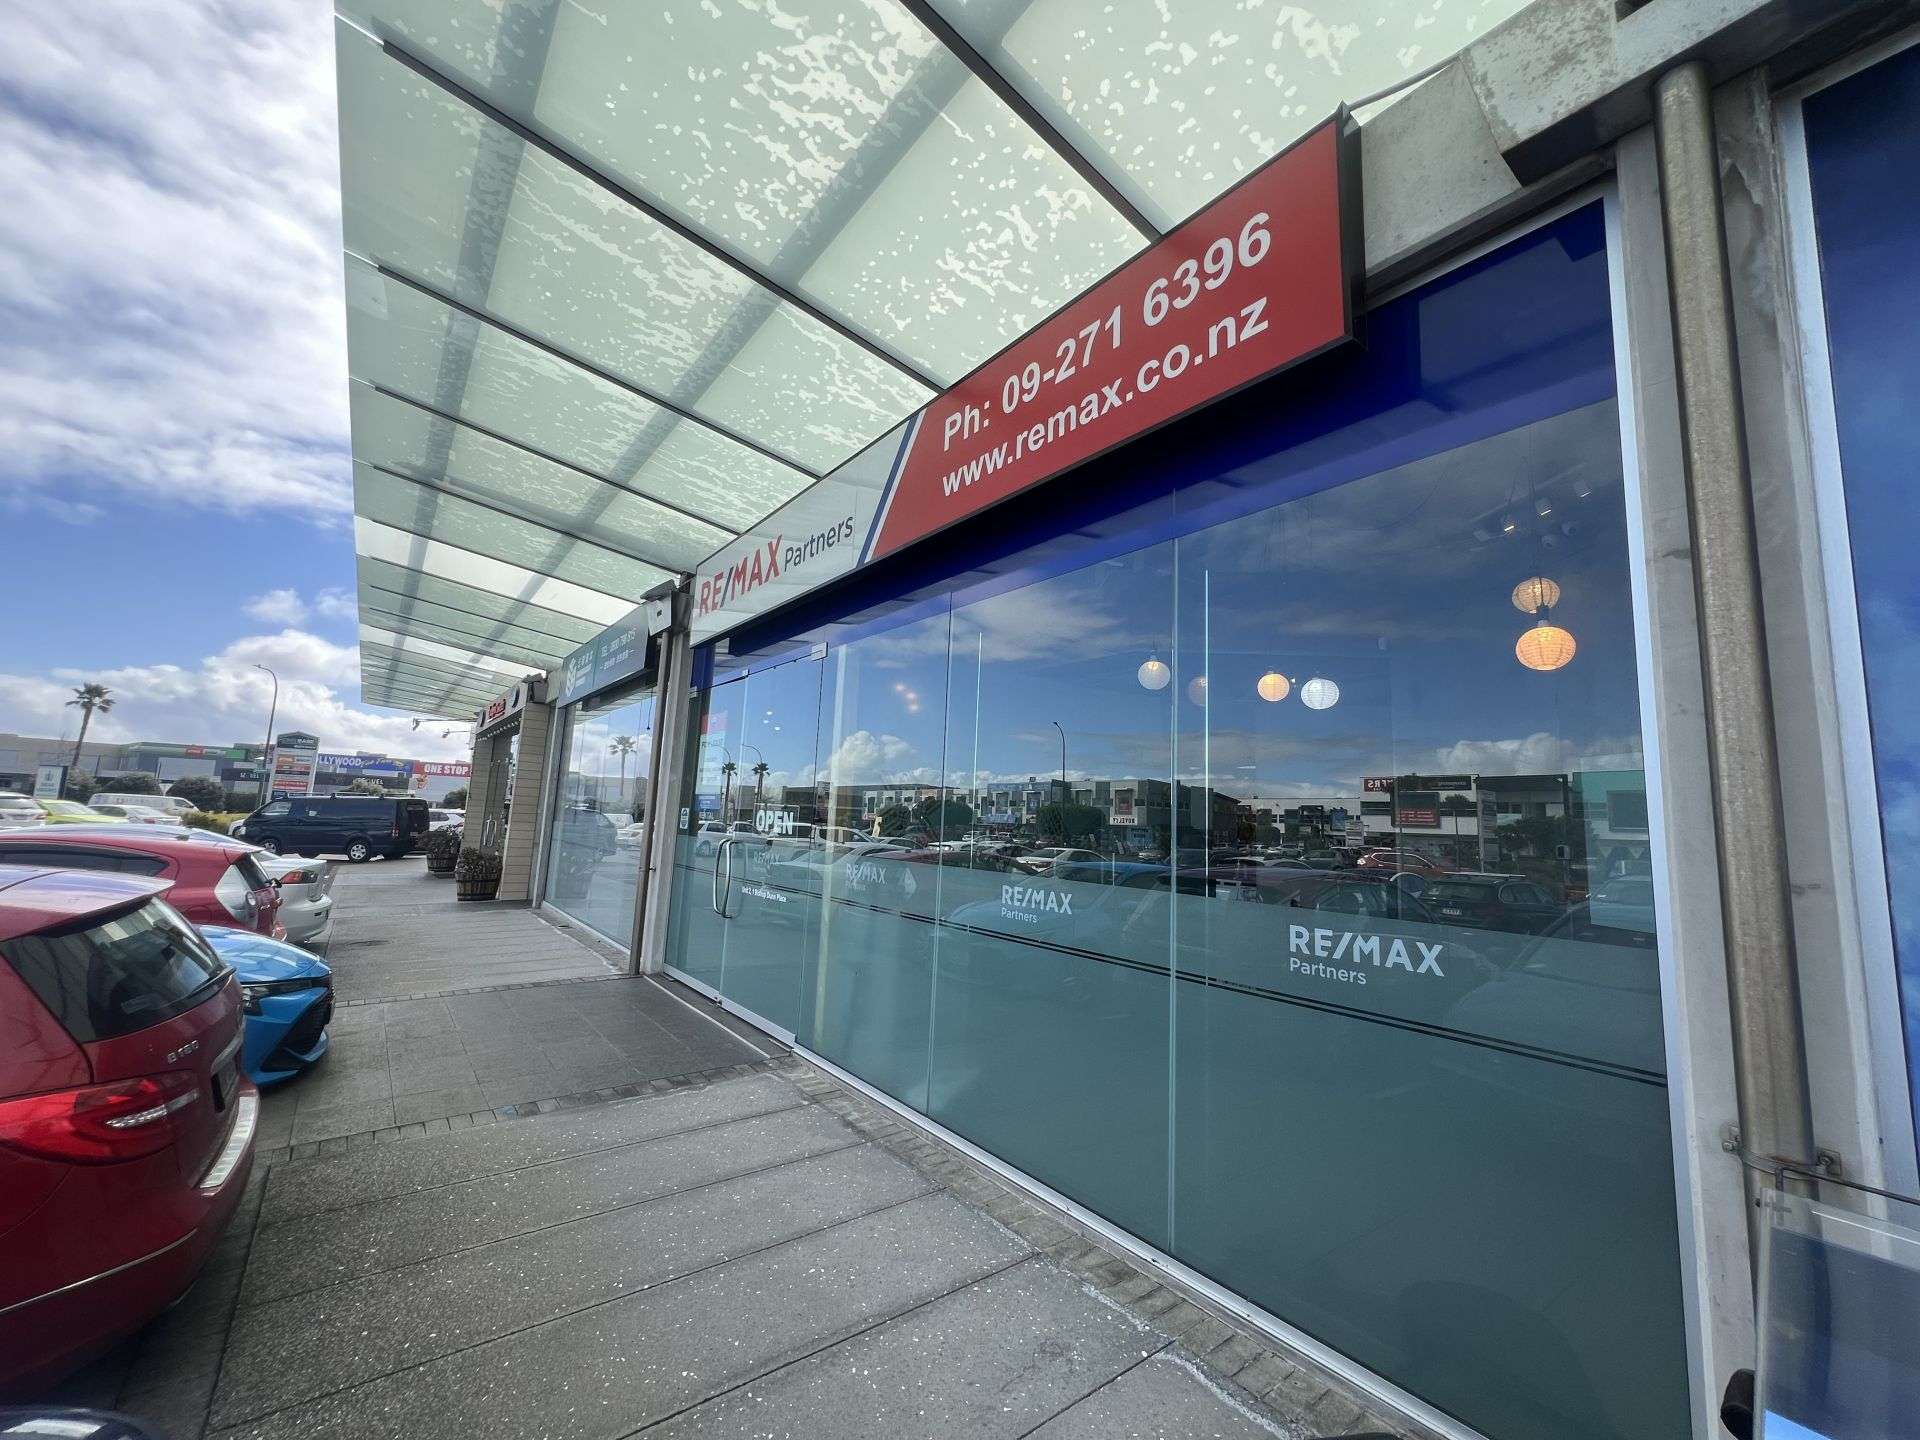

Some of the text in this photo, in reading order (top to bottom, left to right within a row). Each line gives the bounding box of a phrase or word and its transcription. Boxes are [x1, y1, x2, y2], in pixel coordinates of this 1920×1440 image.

[943, 212, 1271, 452] Ph: 09-271 6396
[942, 296, 1269, 496] www.remax.co.nz
[699, 516, 853, 616] RE/MAX Partners
[424, 764, 468, 775] ONE STOP
[756, 810, 794, 835] OPEN
[846, 862, 887, 884] RE/MAX
[1001, 884, 1072, 915] RE/MAX
[1001, 907, 1037, 923] Partners
[1289, 924, 1445, 977] RE/MAX
[1289, 957, 1367, 985] Partners
